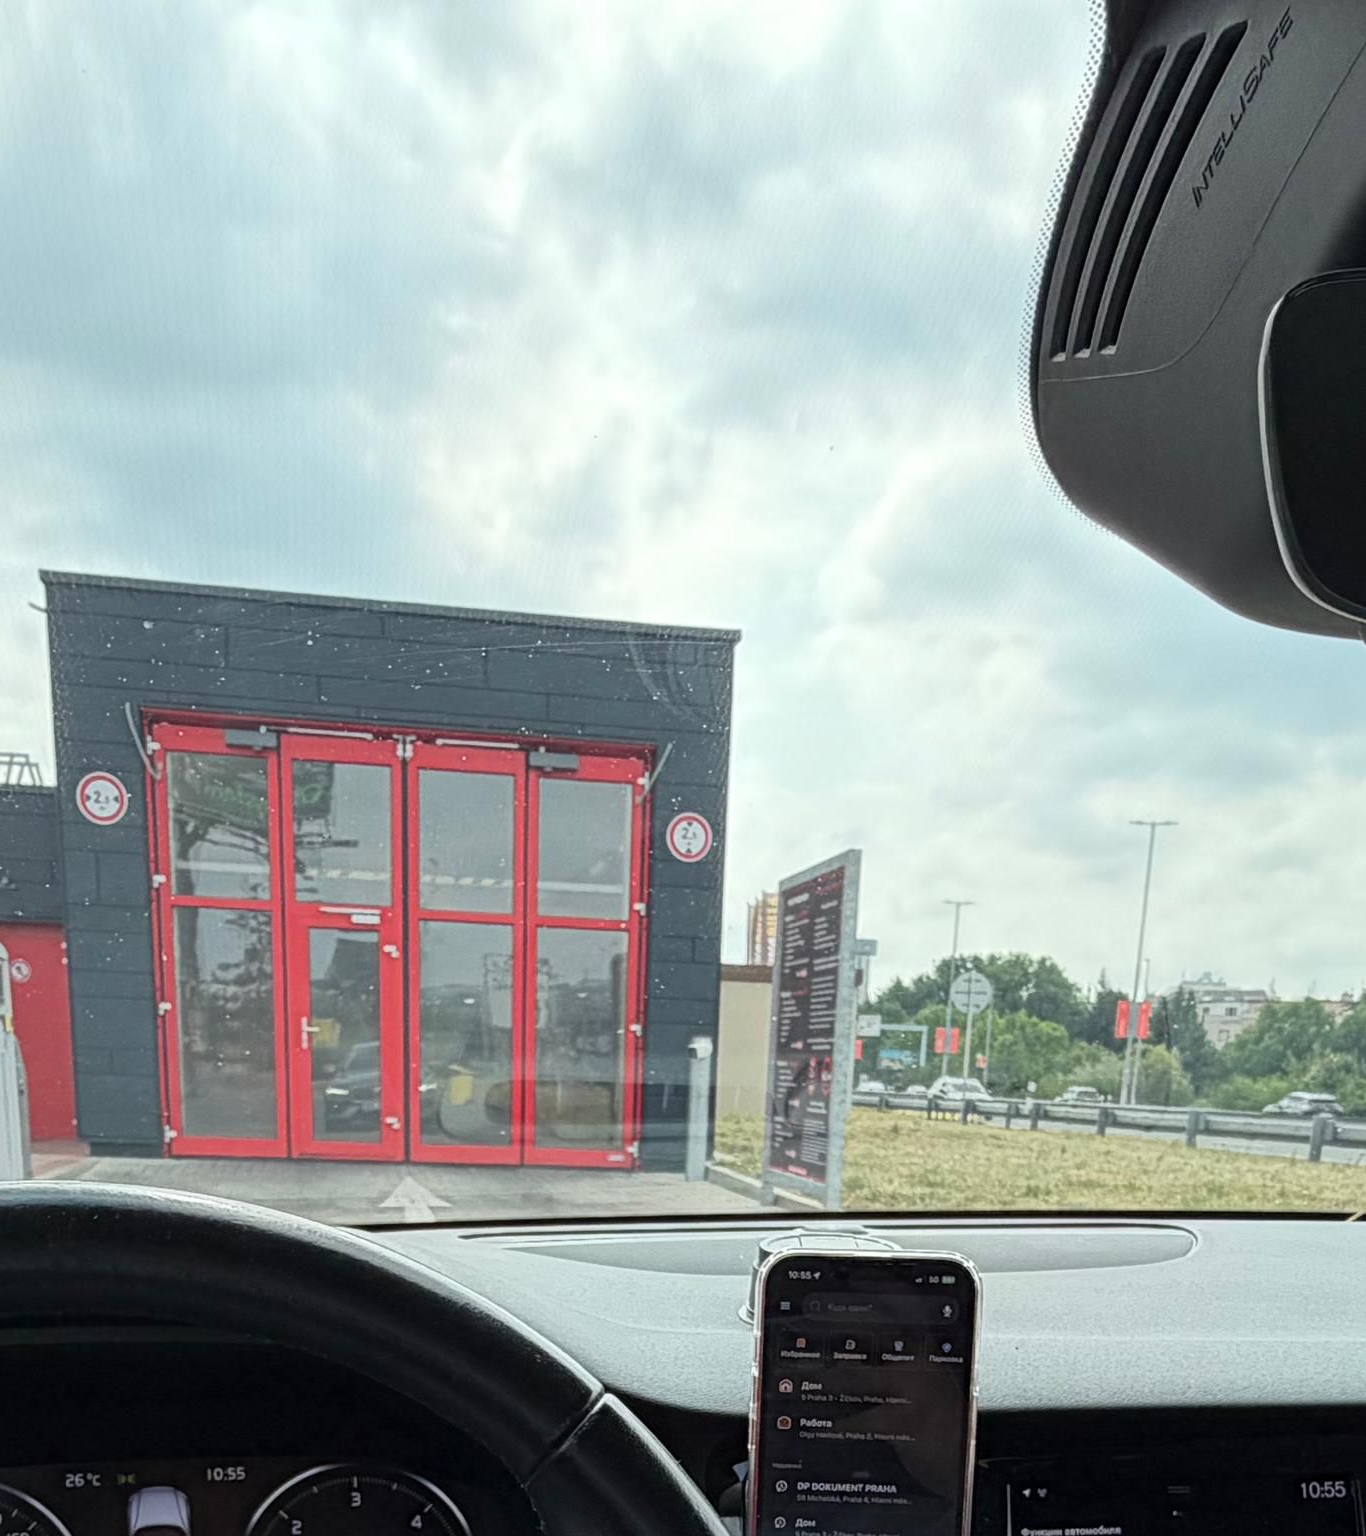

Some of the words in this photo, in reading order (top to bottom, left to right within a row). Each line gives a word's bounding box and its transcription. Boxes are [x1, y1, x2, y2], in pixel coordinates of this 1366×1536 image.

[1190, 6, 1294, 209] INTELLISAFE
[799, 1418, 833, 1429] Работа
[65, 1473, 85, 1488] 26
[206, 1467, 247, 1482] 10:55
[811, 1482, 864, 1493] DOKUMENT
[865, 1484, 898, 1494] PRAHA
[1300, 1480, 1347, 1499] 10:55
[350, 1492, 362, 1507] 3
[291, 1520, 303, 1535] 2
[411, 1514, 423, 1529] 4
[795, 1518, 816, 1528] Дом
